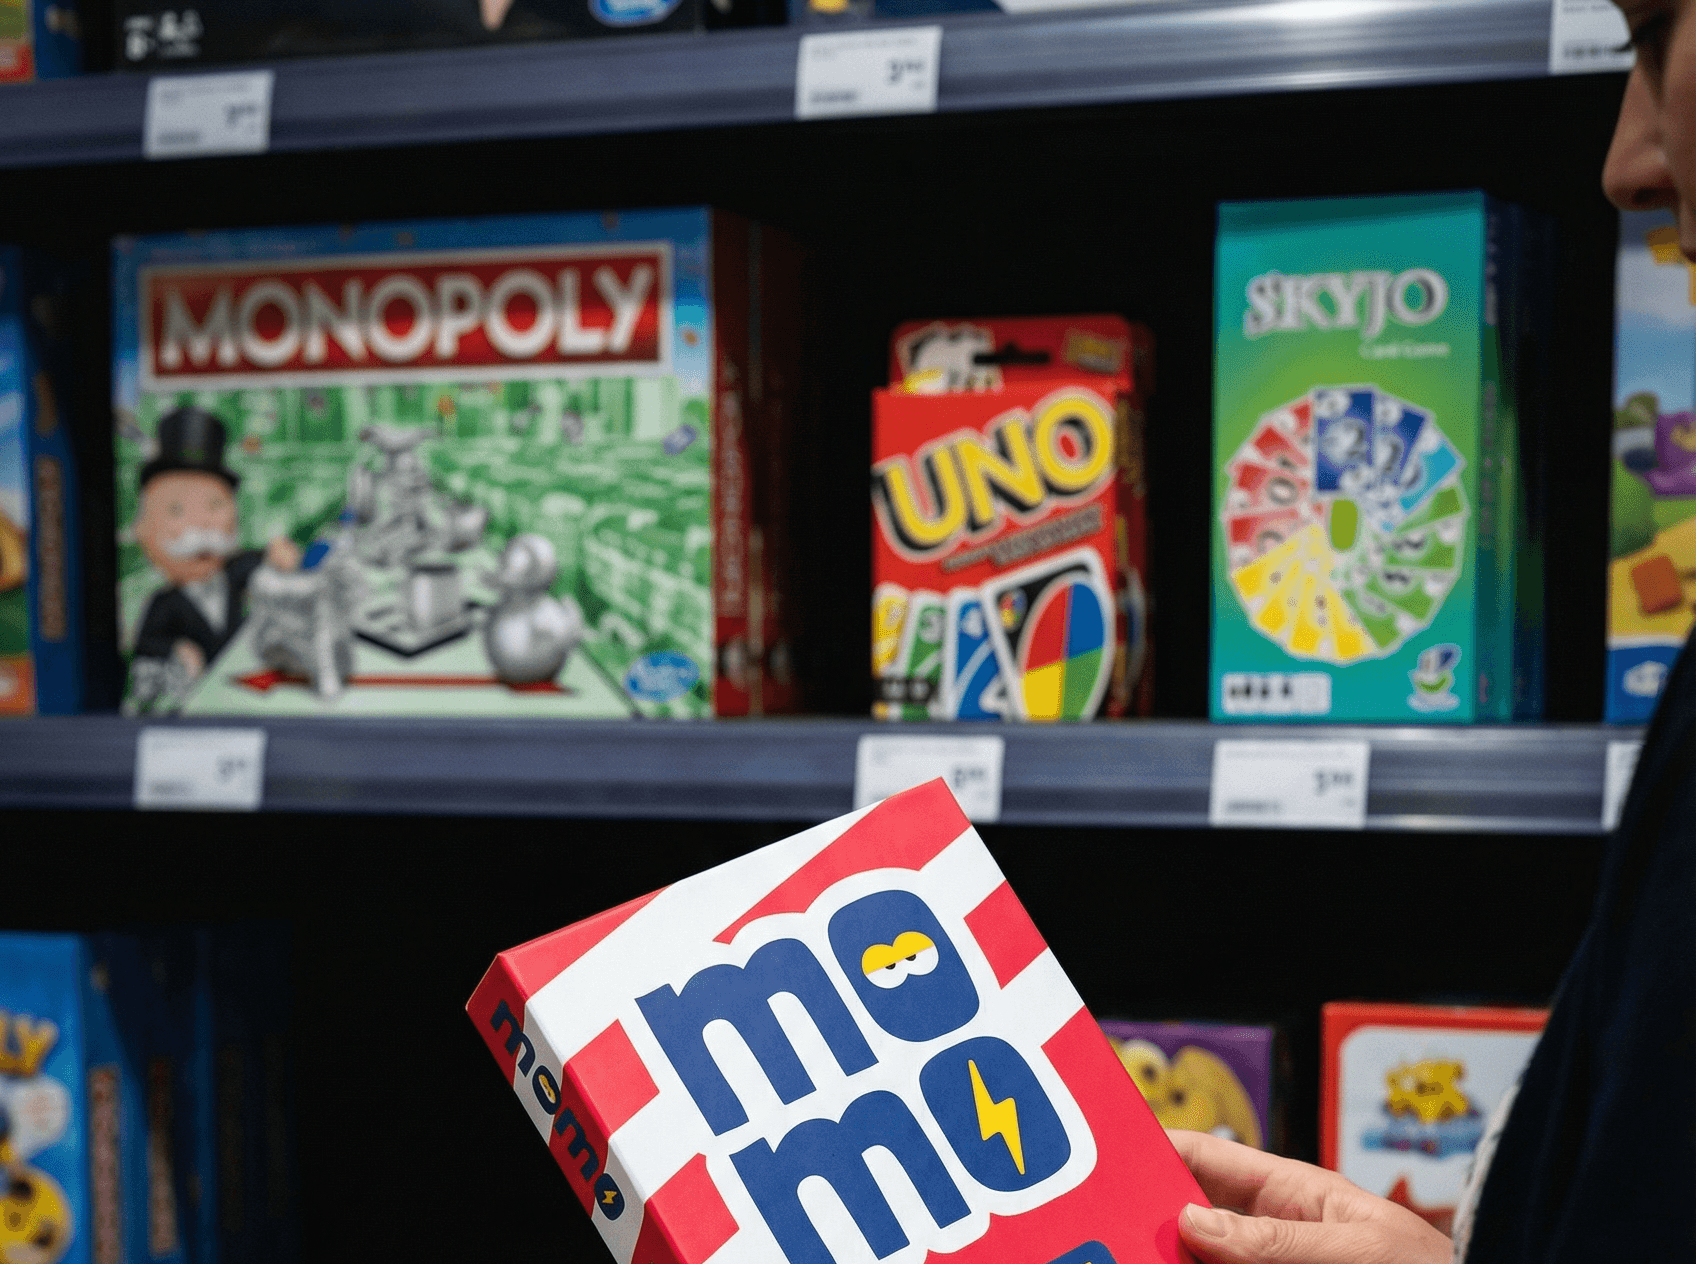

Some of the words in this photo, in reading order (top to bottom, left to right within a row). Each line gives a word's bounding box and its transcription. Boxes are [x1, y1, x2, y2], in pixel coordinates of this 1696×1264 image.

[161, 264, 653, 367] MONOPOLY
[1244, 268, 1449, 339] SKYJO
[876, 390, 1115, 553] UNO
[490, 1000, 626, 1221] momo
